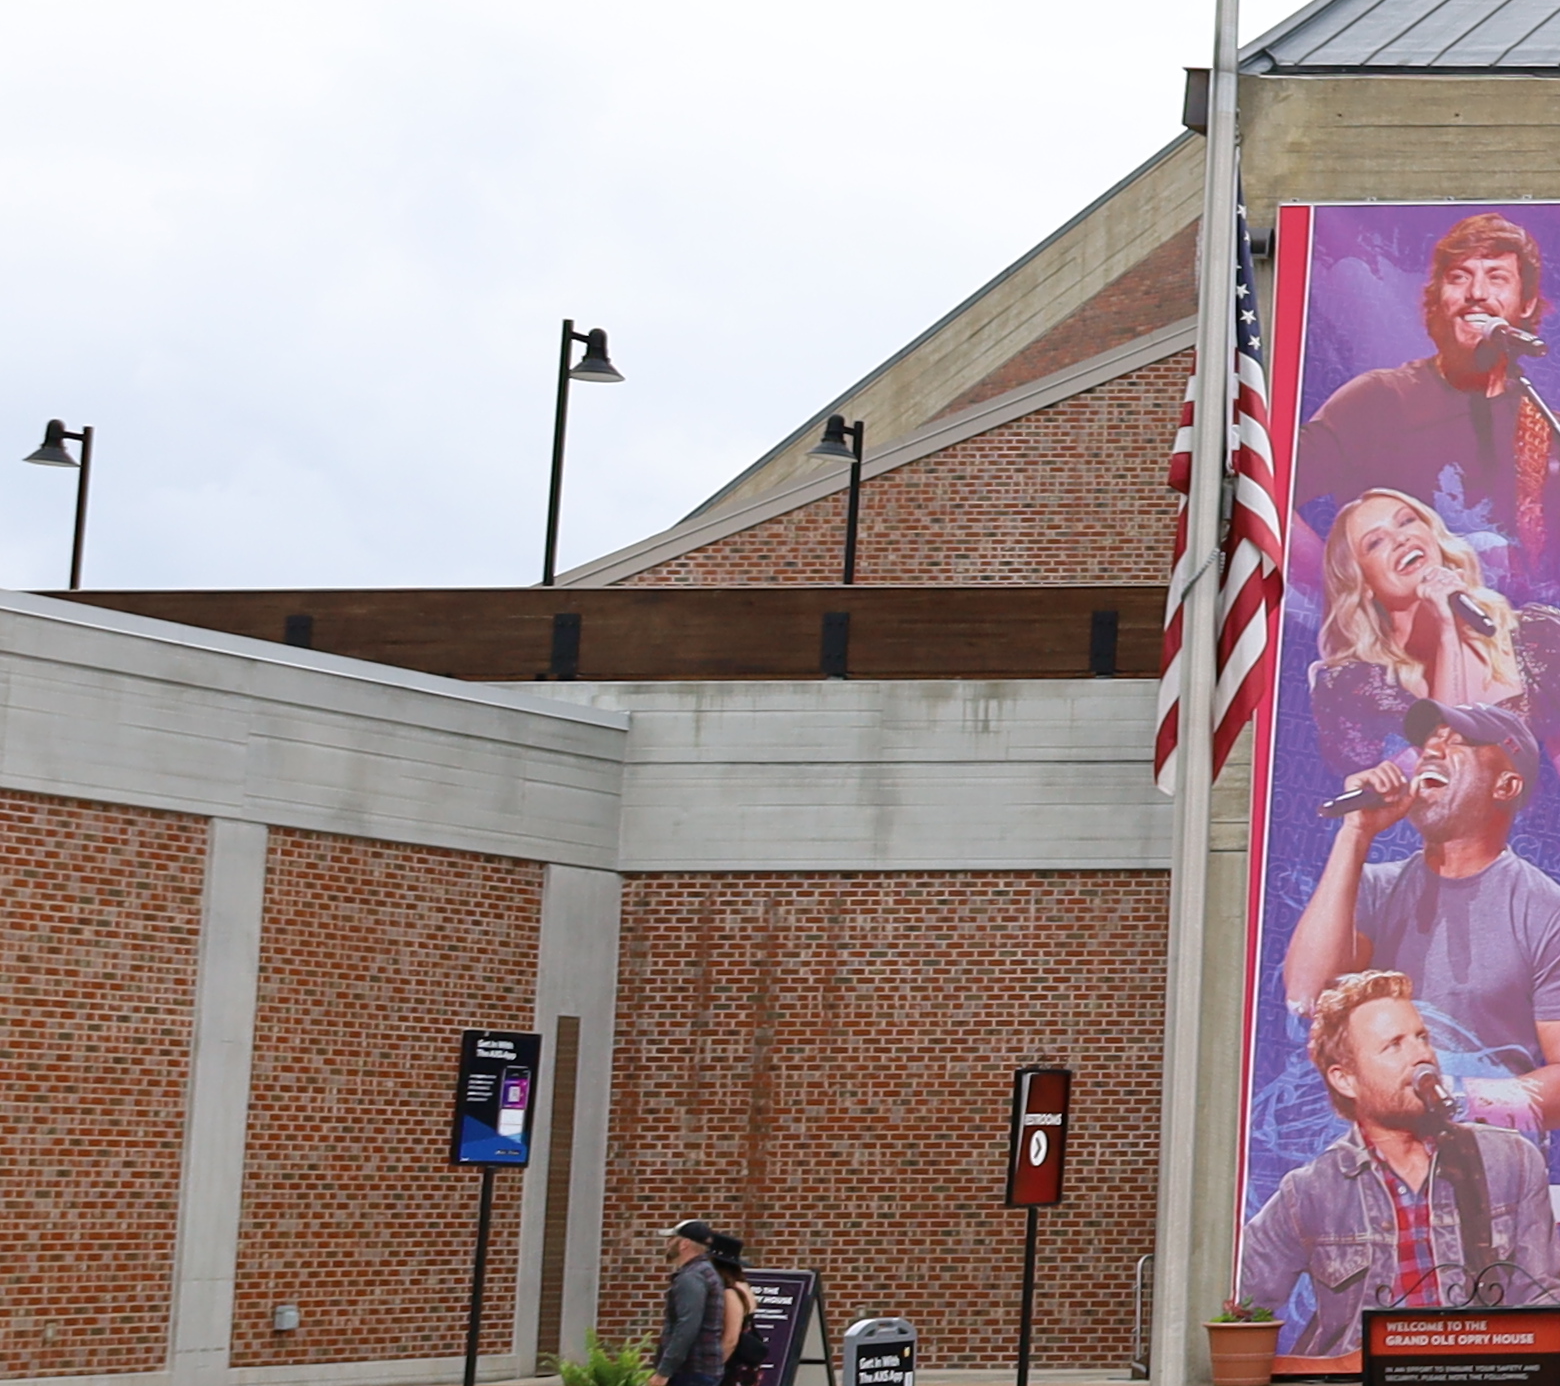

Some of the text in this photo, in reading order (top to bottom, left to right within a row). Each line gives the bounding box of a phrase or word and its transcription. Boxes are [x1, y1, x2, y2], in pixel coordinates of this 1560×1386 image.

[1386, 1320, 1487, 1332] WELCOME TO THE
[1385, 1333, 1535, 1346] GRAND OLE OPRY HOUSE
